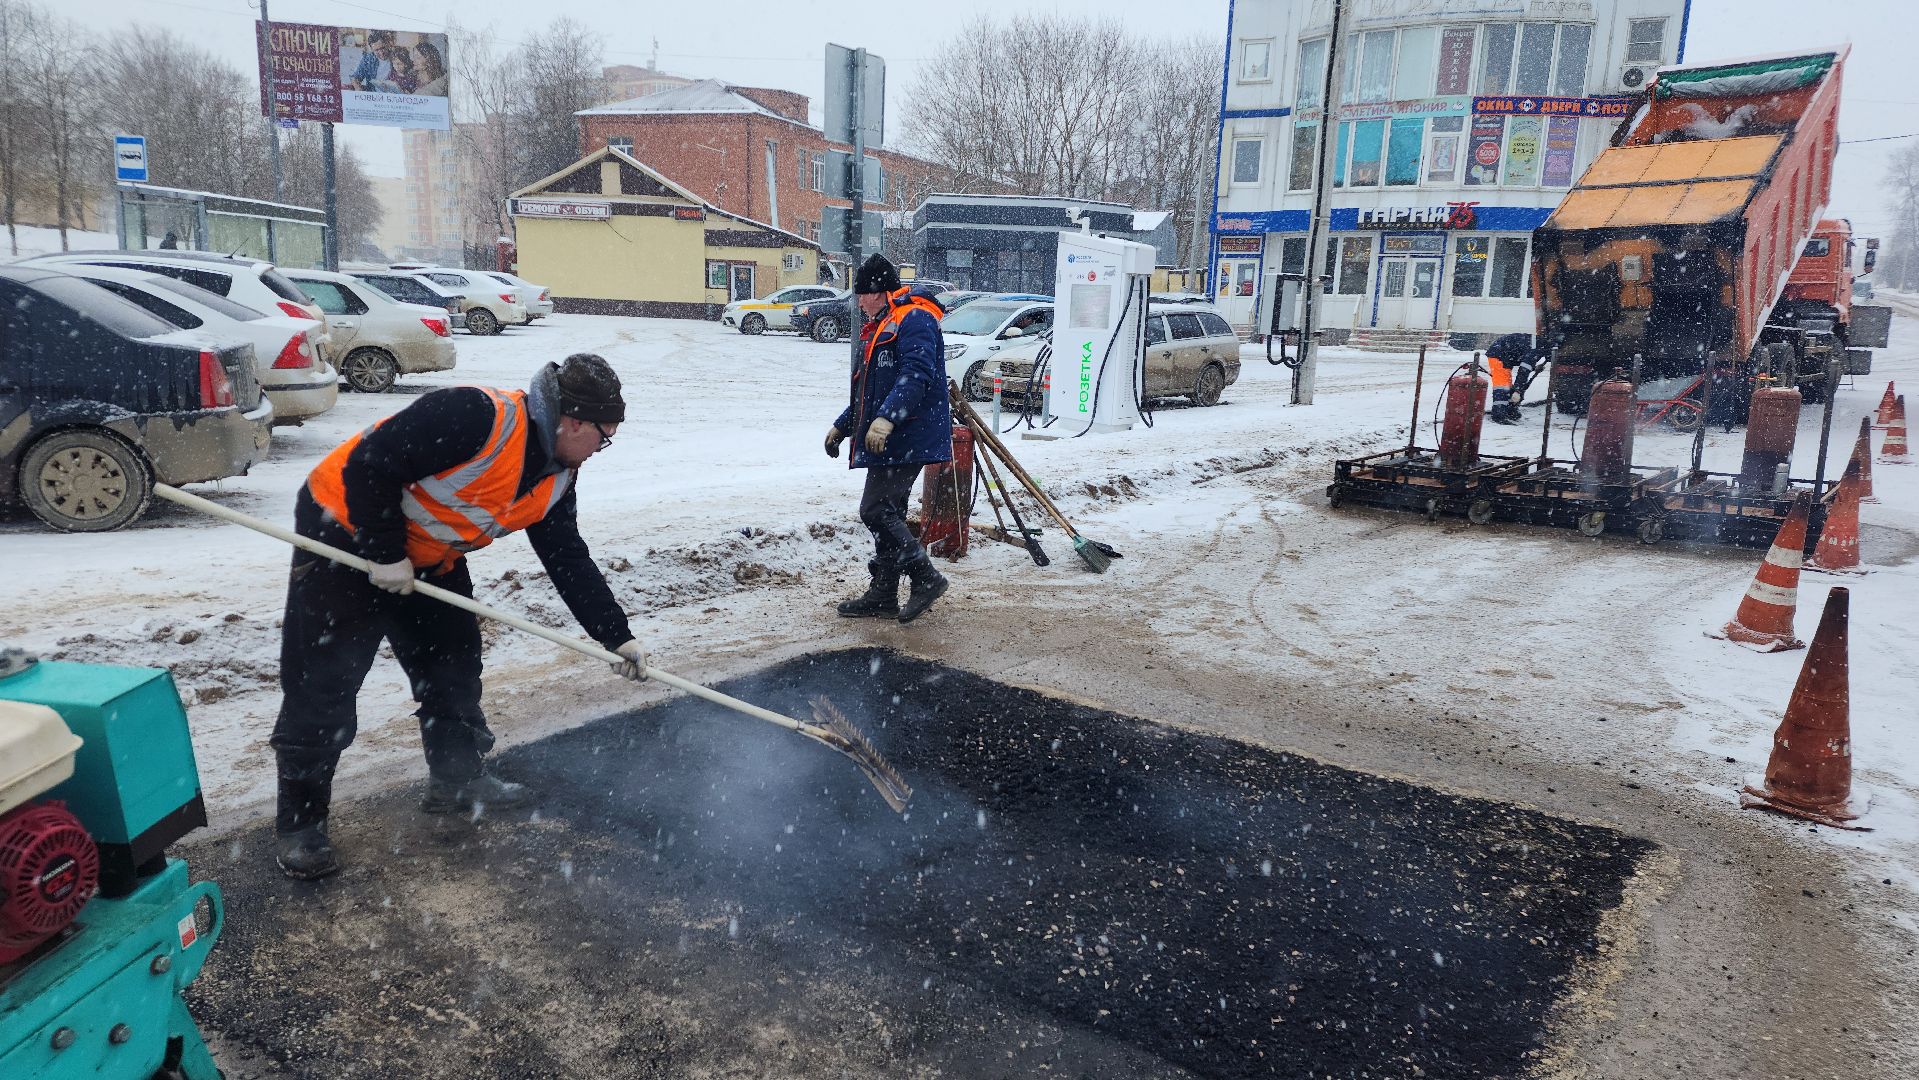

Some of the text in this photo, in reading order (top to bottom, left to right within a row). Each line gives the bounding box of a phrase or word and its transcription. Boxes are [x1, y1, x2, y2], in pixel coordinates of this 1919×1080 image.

[282, 56, 333, 74] СЧАСТЬЯ
[1394, 102, 1447, 115] ЯПОНИЯ
[1476, 101, 1515, 111] ОКНА
[1540, 101, 1581, 113] ДВЕРИ
[1601, 103, 1629, 114] ПОТ
[520, 203, 606, 216] РЕМОНТ ОБУВИ
[1357, 206, 1451, 223] ГАРАЖ
[1079, 341, 1092, 413] РОЗЕТКА
